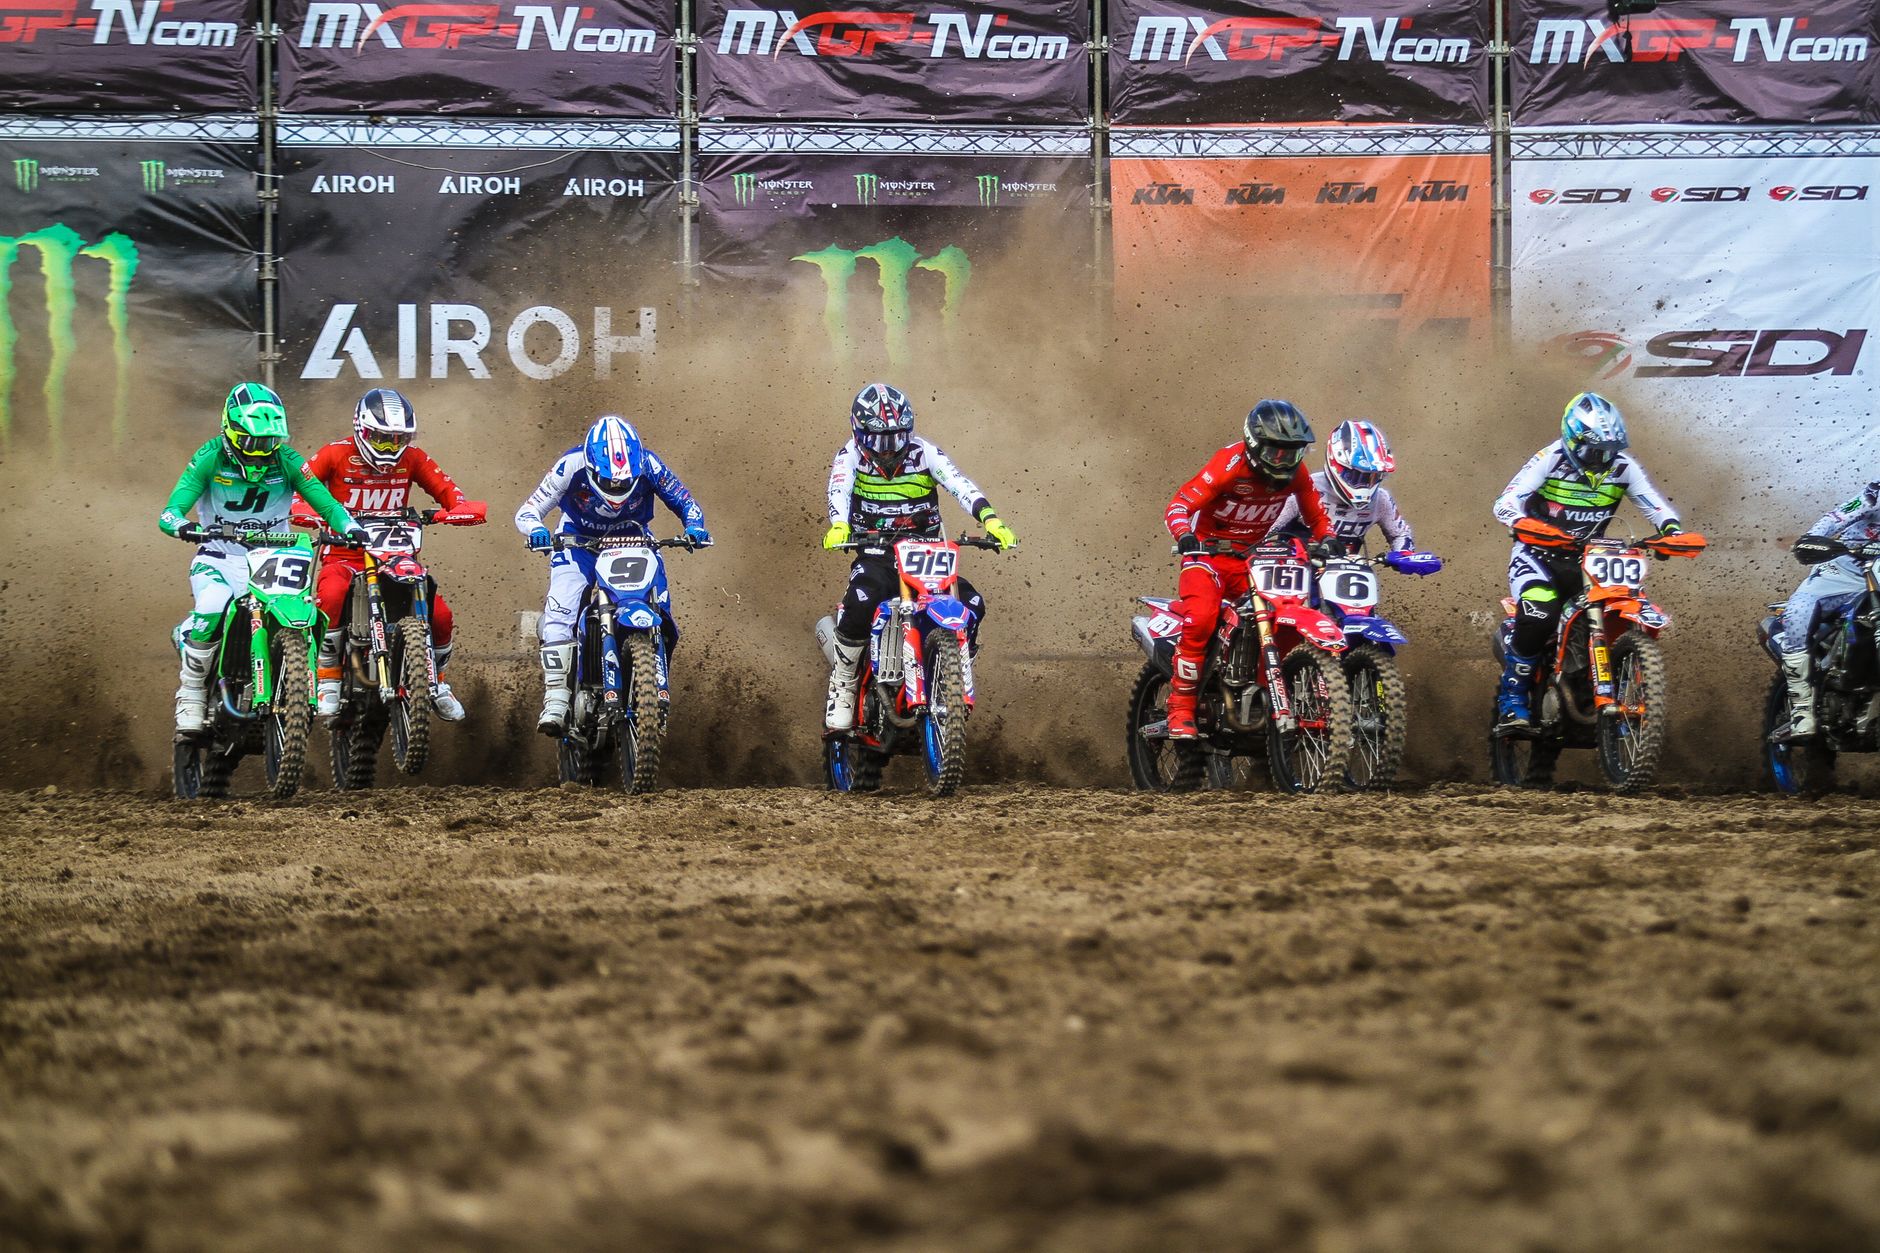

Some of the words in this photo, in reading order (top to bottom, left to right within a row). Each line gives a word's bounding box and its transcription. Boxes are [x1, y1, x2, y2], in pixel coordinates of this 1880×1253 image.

[311, 175, 395, 193] AIROH
[438, 176, 521, 194] AIROH
[563, 178, 644, 197] AIROH
[757, 180, 814, 190] MONSTER
[879, 181, 936, 191] MONSTER
[1001, 182, 1057, 192] MONSTER
[1131, 183, 1195, 205] KTM
[1224, 183, 1286, 205] KTM
[1314, 182, 1378, 204] KTM
[1407, 180, 1469, 202] KTM
[300, 303, 657, 381] AIROH
[344, 488, 405, 510] JWR
[861, 500, 931, 515] Beta
[1213, 500, 1282, 522] JWR
[1564, 509, 1610, 522] YUASA
[580, 518, 633, 531] YAMAHA
[371, 527, 415, 547] 75
[251, 557, 310, 589] 43
[608, 557, 648, 584] 9
[905, 550, 955, 576] 919
[1592, 557, 1641, 585] 303
[1260, 565, 1305, 591] 161
[1335, 572, 1369, 600] 6
[1177, 657, 1198, 680] G
